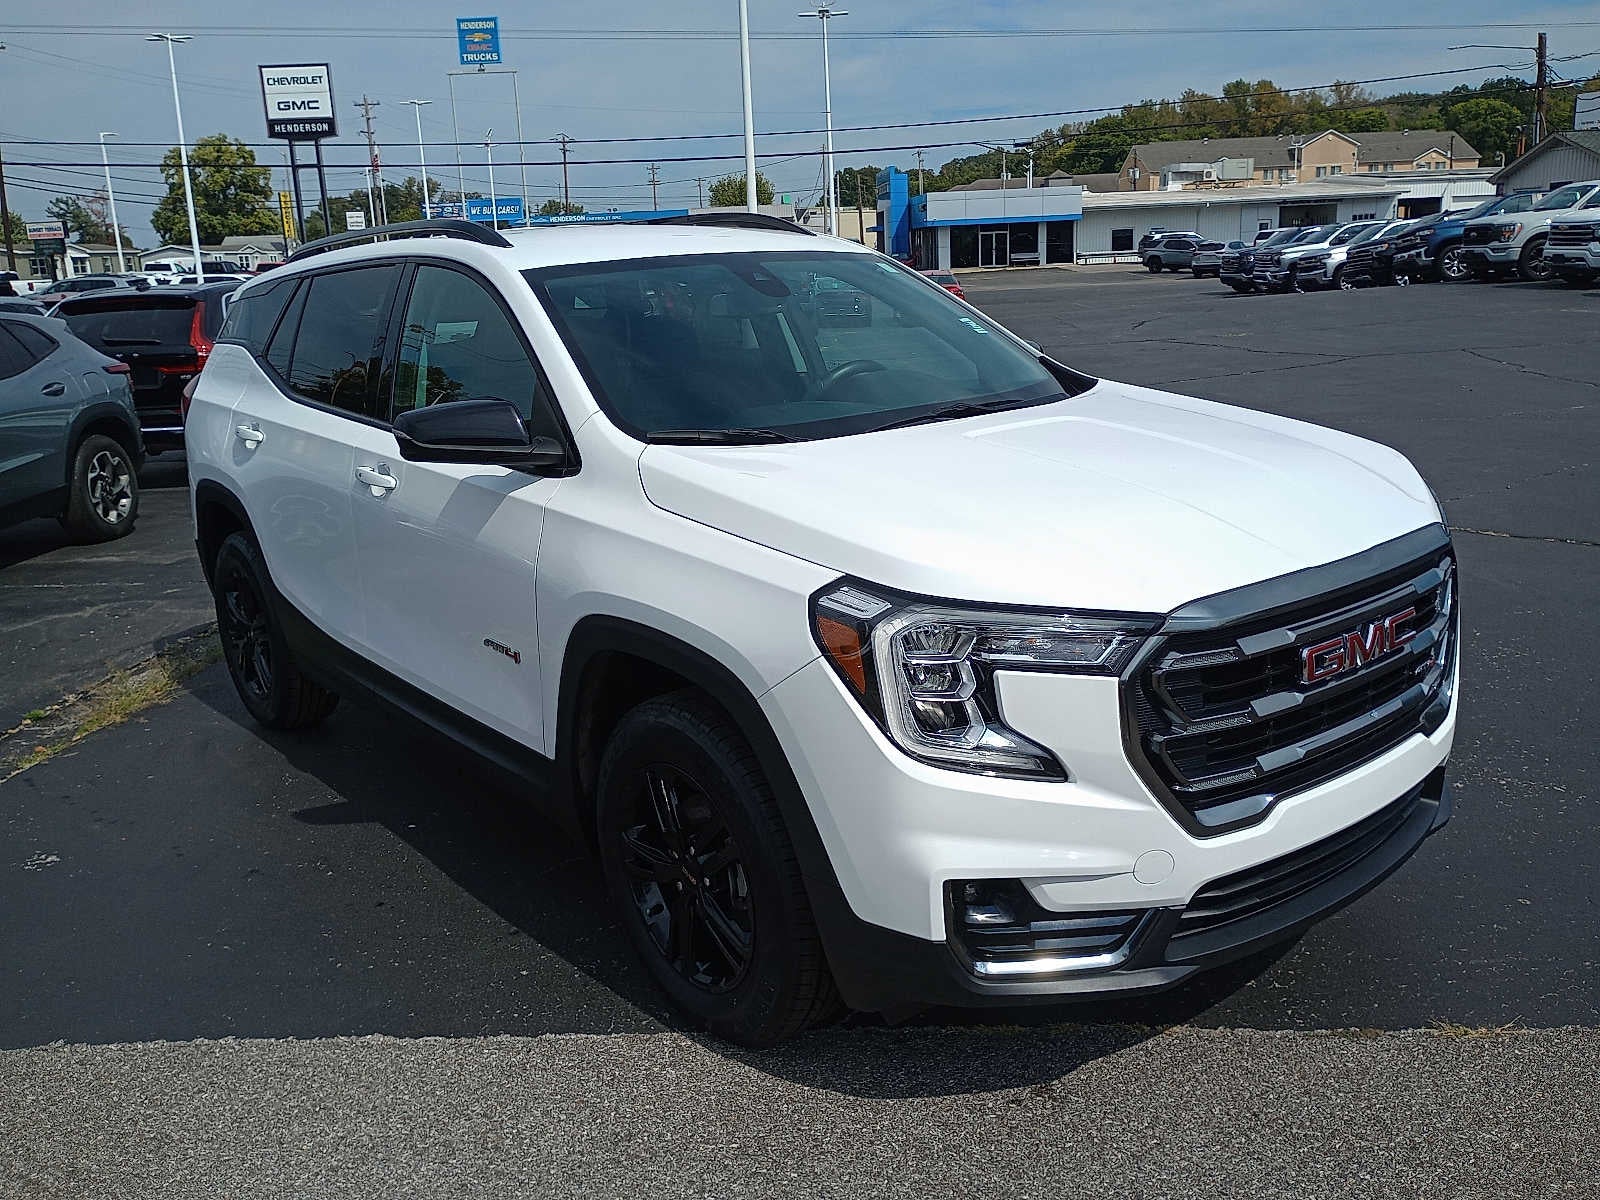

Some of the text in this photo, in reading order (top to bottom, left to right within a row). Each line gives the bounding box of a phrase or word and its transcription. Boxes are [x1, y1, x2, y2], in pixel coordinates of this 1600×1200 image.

[460, 21, 495, 29] HENDERSON
[467, 43, 493, 51] GMC
[462, 52, 499, 61] TRUCKS
[266, 75, 323, 86] CHEVROLET
[277, 100, 320, 111] GMC
[274, 122, 329, 133] HENDERSON
[470, 206, 481, 215] WE
[549, 215, 586, 223] HENDERSON
[1299, 606, 1417, 685] GMC
[483, 638, 522, 665] AT4
